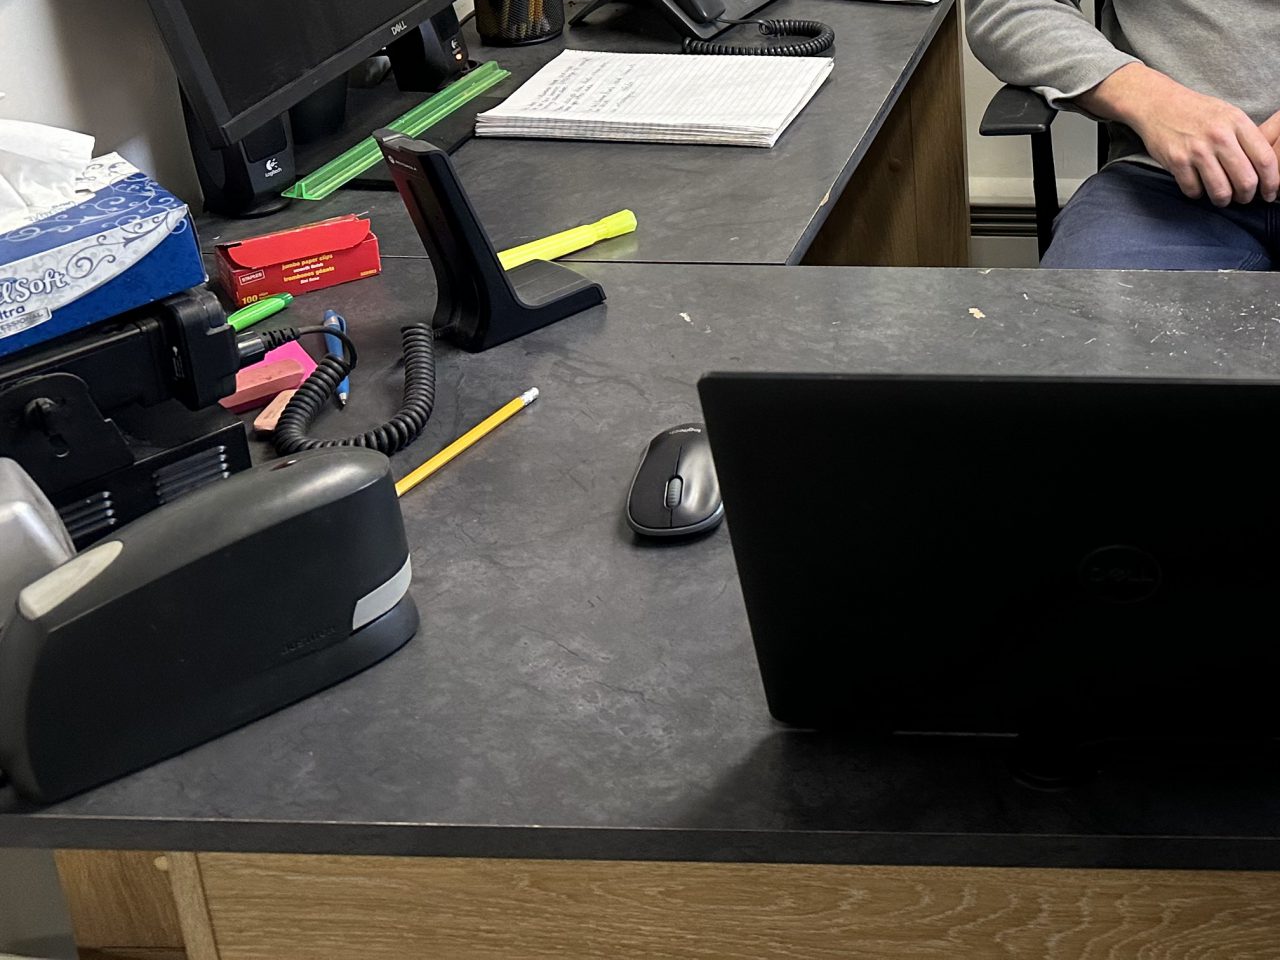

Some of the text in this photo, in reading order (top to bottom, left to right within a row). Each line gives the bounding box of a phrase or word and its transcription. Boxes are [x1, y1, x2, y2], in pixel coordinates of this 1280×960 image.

[391, 20, 408, 36] DELL
[264, 167, 283, 178] Logitech
[281, 253, 333, 271] jumbo paper clips
[240, 272, 264, 284] STAPLES
[283, 271, 315, 282] trombones
[15, 268, 70, 303] Soft
[241, 294, 258, 305] 100
[0, 305, 26, 321] ltra
[0, 311, 44, 334] ESSIONAL
